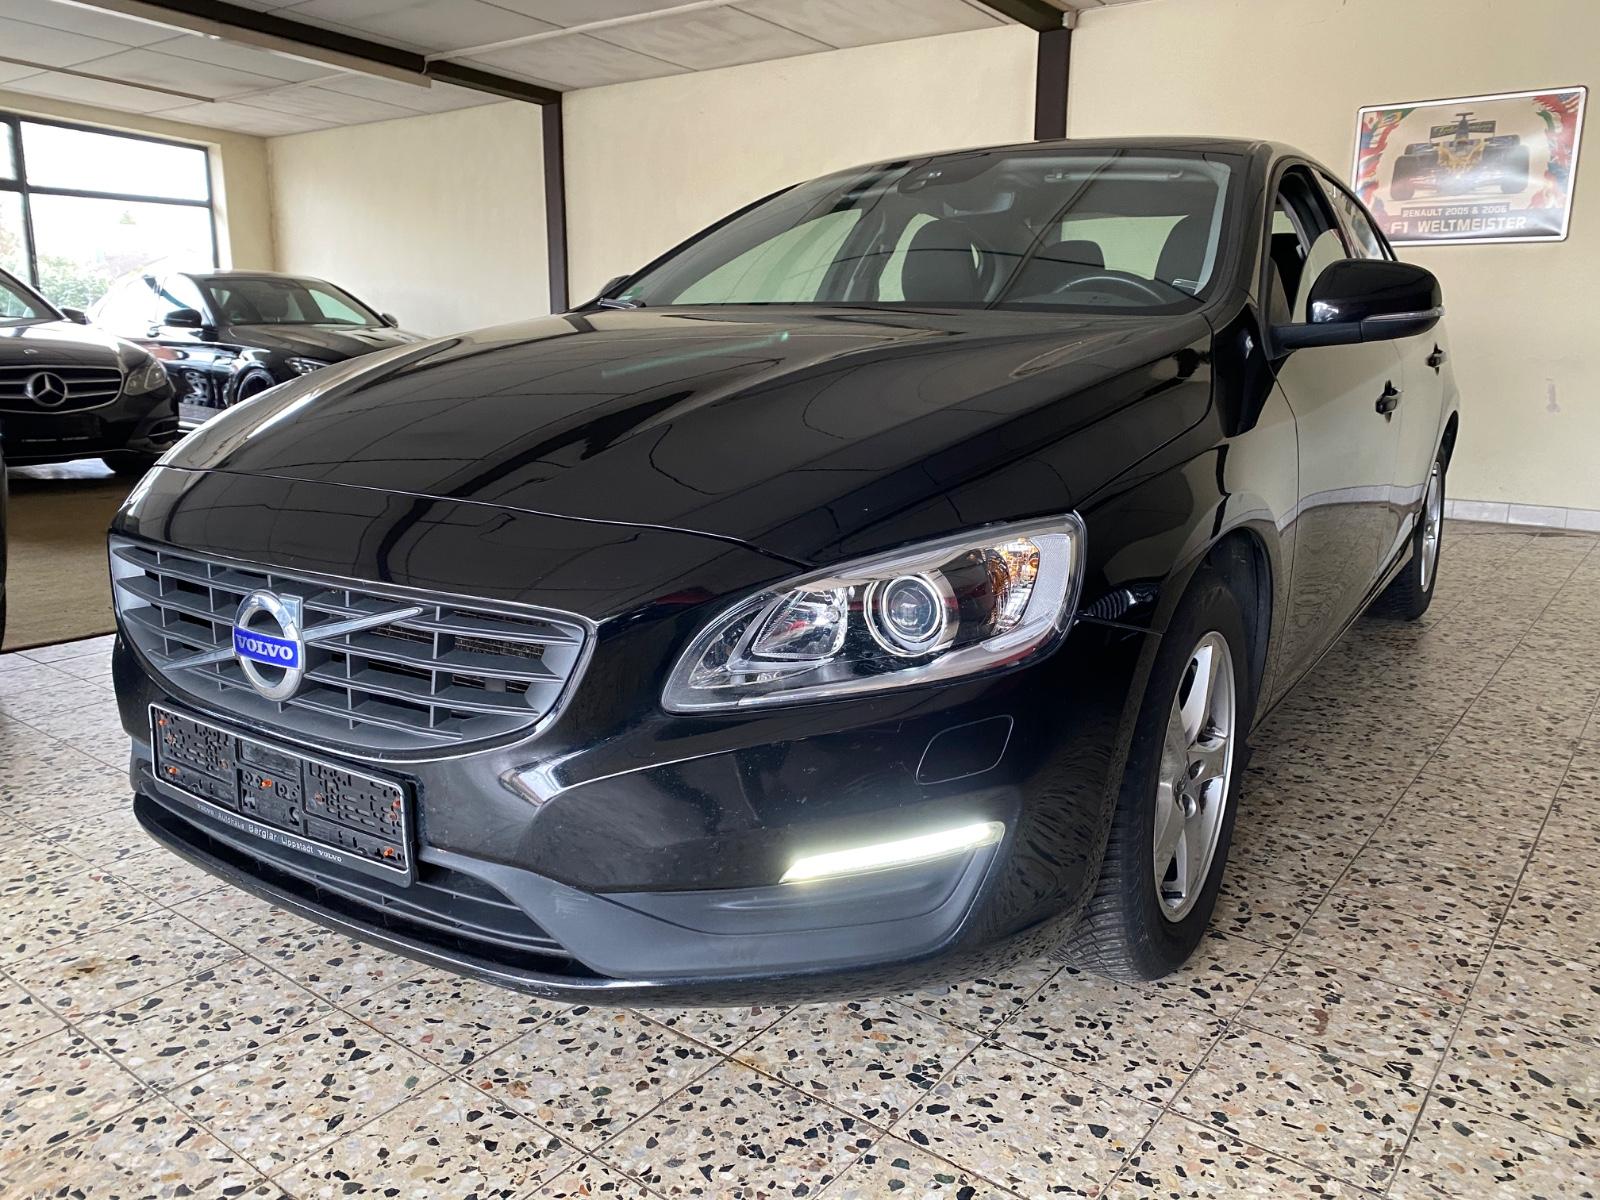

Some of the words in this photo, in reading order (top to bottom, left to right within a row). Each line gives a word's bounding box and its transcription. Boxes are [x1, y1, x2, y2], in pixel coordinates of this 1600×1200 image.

[1402, 208, 1442, 217] RENAULT
[1445, 207, 1469, 216] 2005
[1471, 206, 1479, 214] &
[1482, 205, 1508, 213] 2006
[1391, 221, 1408, 234] F1
[1417, 216, 1527, 233] WELTMEISTER
[236, 633, 293, 660] VOLVO
[281, 836, 314, 855] Lippstadt
